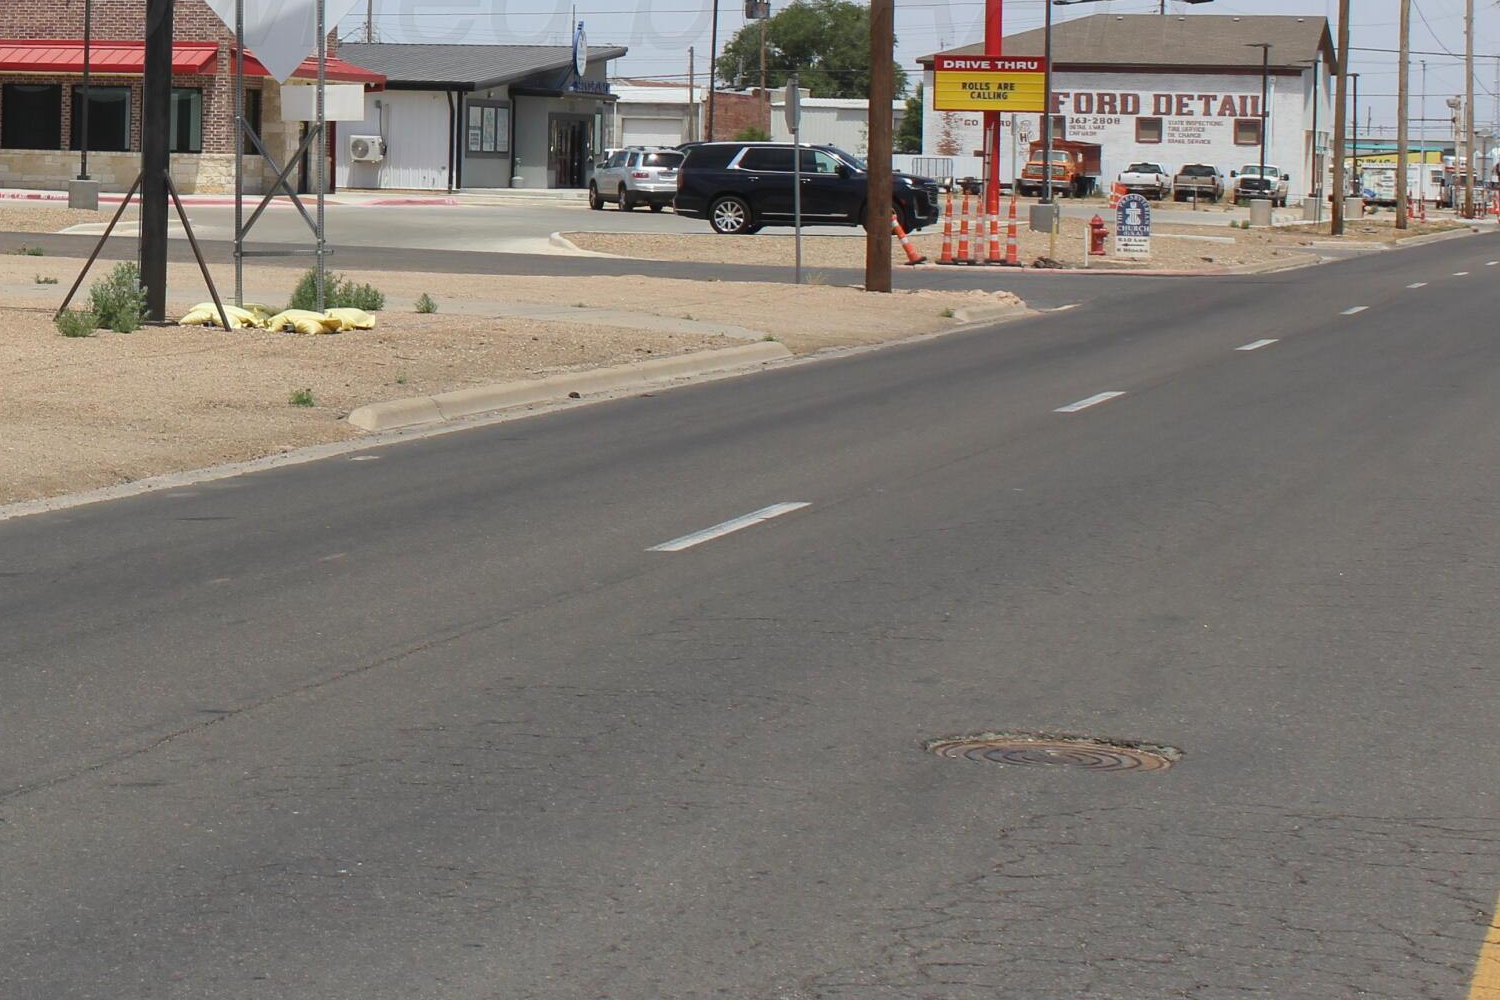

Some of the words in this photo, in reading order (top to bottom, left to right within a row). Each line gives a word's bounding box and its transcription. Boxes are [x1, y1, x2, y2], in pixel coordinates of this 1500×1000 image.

[943, 60, 991, 69] DRIVE
[995, 61, 1038, 70] THRU
[962, 82, 991, 91] ROLLS
[997, 83, 1015, 91] ARE
[970, 91, 1008, 100] CALLING
[1051, 92, 1140, 115] FORD
[1152, 94, 1269, 117] DETAIL
